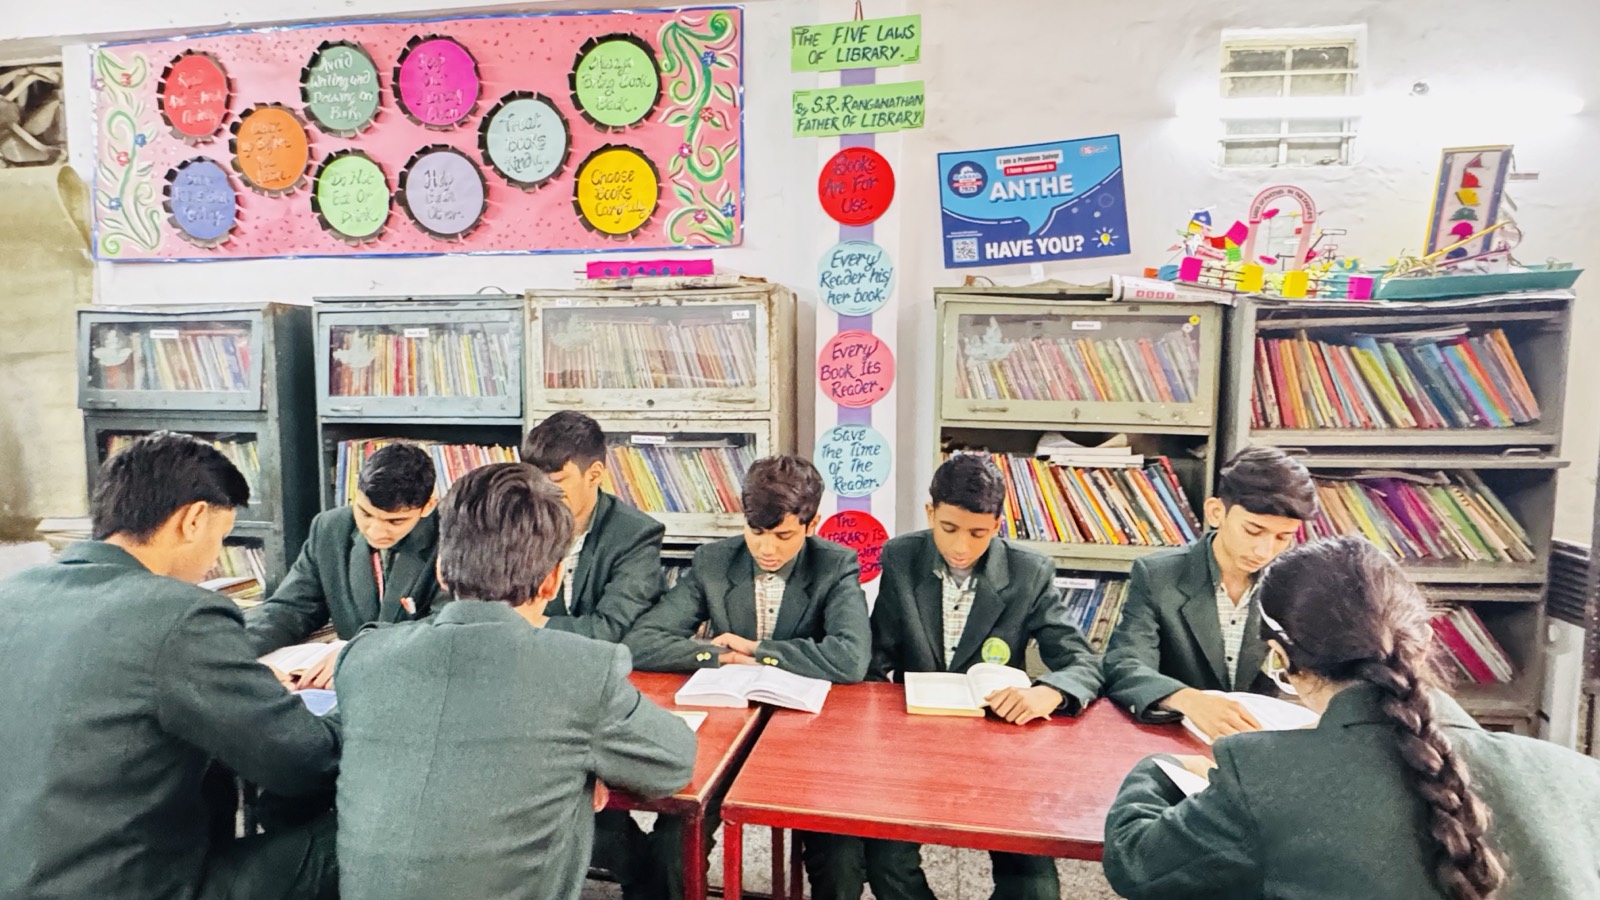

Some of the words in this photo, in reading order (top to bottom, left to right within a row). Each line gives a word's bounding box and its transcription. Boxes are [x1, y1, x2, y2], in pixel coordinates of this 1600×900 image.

[796, 28, 821, 47] THE
[832, 25, 871, 45] FIVE
[877, 24, 915, 44] LAWS
[808, 48, 828, 65] OF
[836, 46, 905, 63] LIBRARY.
[797, 117, 840, 132] FATHER
[842, 117, 857, 128] OF
[861, 111, 921, 128] LIBRARY
[832, 153, 877, 175] Books
[989, 174, 1074, 202] ANTHE
[985, 239, 1034, 259] HAVE
[1036, 235, 1084, 254] YOU?
[830, 250, 882, 272] Every
[832, 340, 879, 361] Every
[820, 363, 856, 381] Book
[832, 427, 866, 442] Save
[821, 443, 843, 459] The
[850, 441, 881, 457] Time
[850, 458, 873, 473] The
